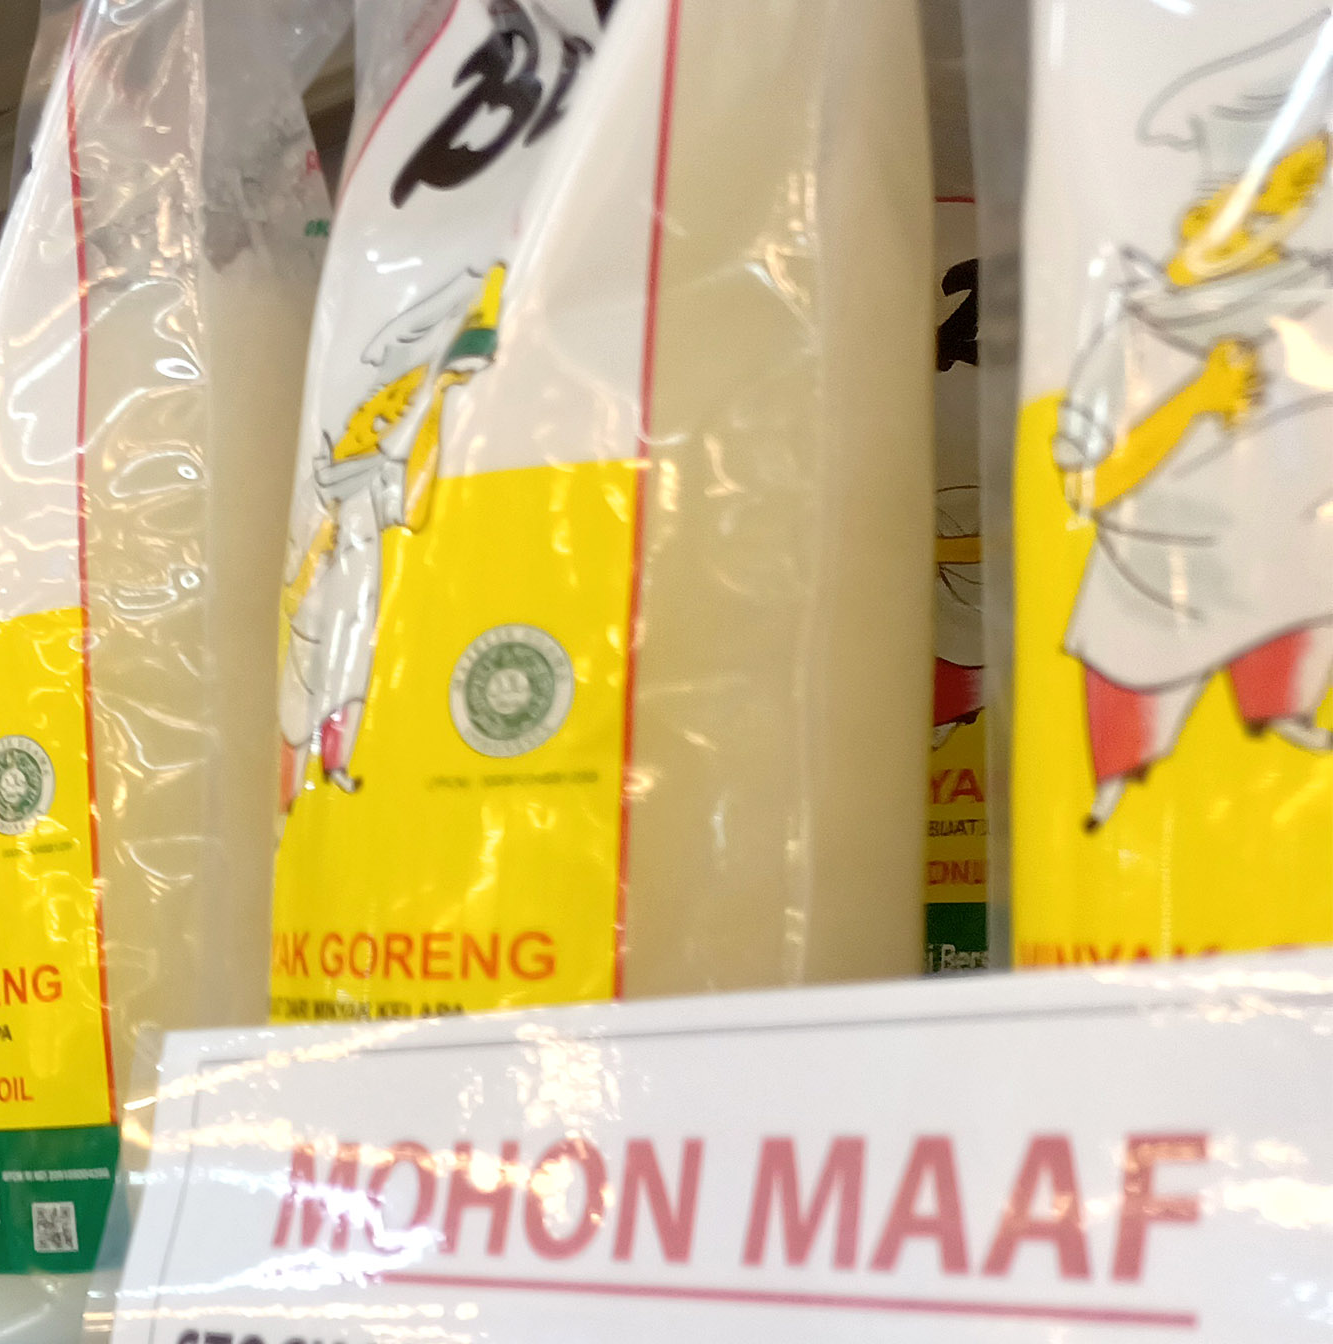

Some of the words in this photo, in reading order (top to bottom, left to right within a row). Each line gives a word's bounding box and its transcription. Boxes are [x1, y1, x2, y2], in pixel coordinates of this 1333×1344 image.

[318, 931, 558, 980] GORENG
[271, 1132, 706, 1264] MOHON
[740, 1131, 1211, 1285] MAAF
